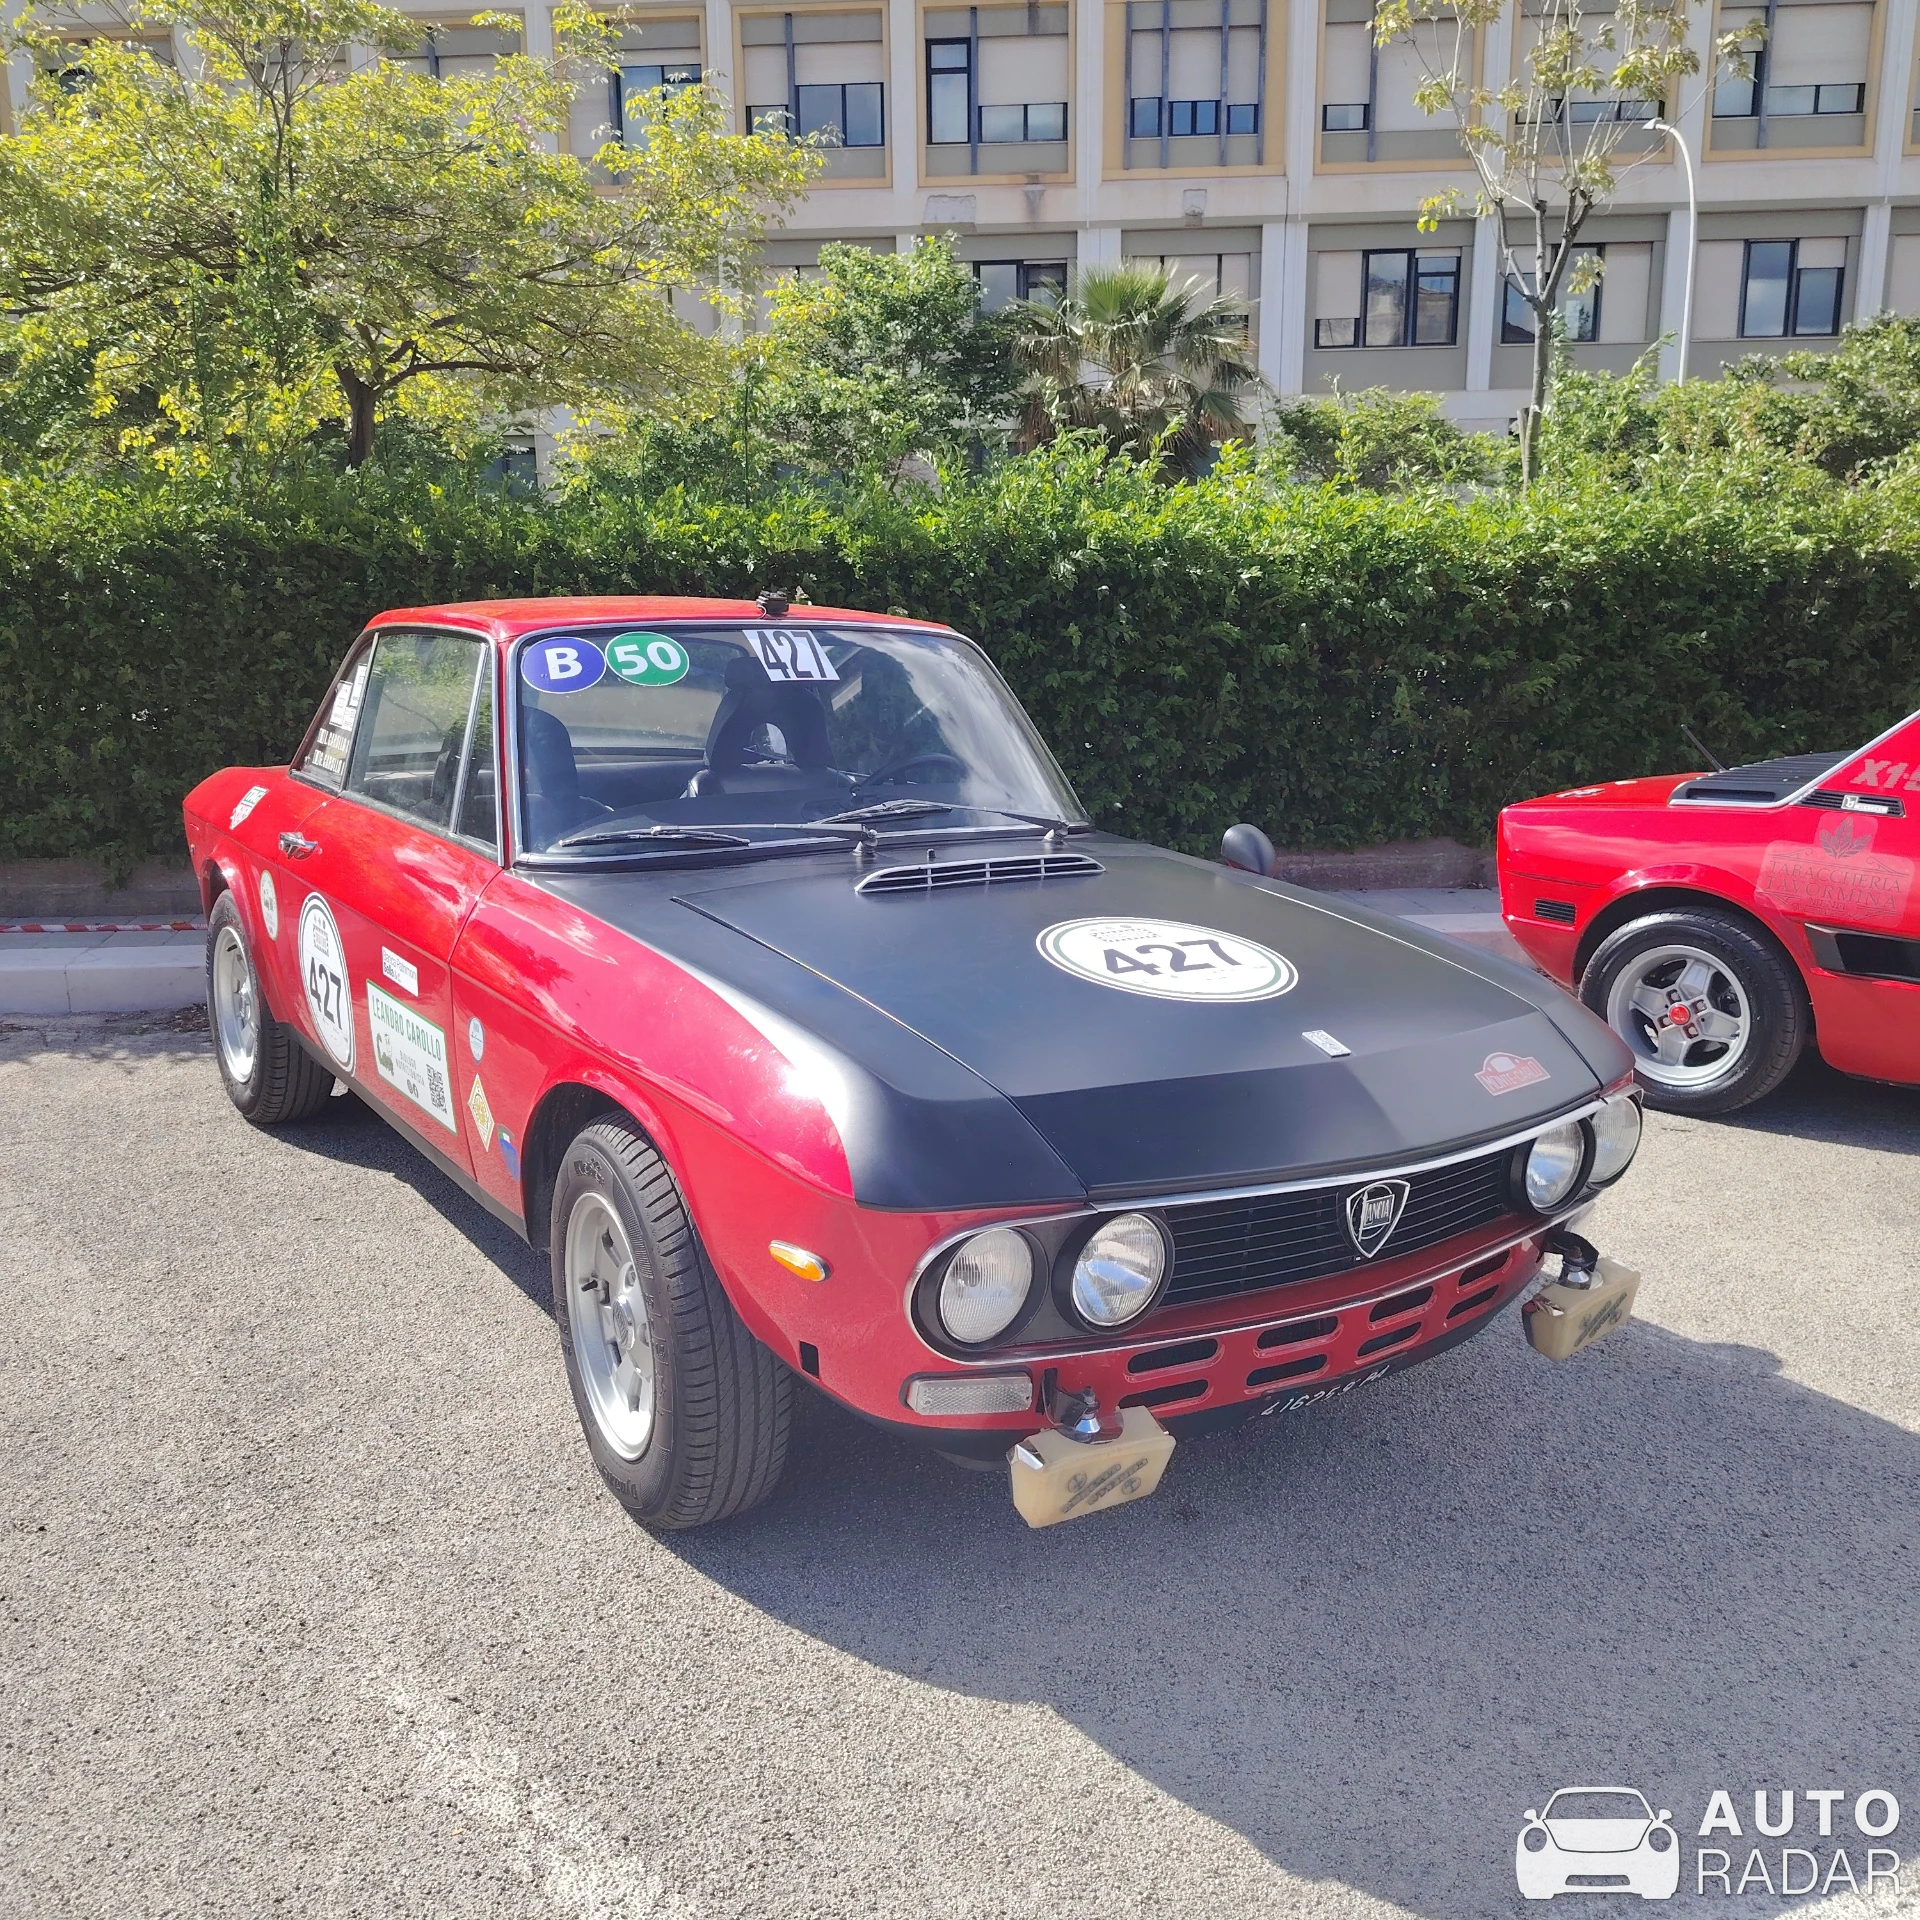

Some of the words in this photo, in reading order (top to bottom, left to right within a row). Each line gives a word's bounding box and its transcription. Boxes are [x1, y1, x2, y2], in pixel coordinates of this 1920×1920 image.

[545, 647, 583, 680] B
[613, 642, 682, 676] 50
[756, 630, 828, 679] 427
[1765, 875, 1898, 909] TAVORMINA
[1769, 860, 1902, 893] TABACCHERIA
[1102, 939, 1244, 976] 427
[309, 956, 343, 1031] 427
[371, 994, 405, 1037] LEANDRO
[406, 1018, 442, 1062] CAROLLO
[1363, 1199, 1391, 1227] LANCIA
